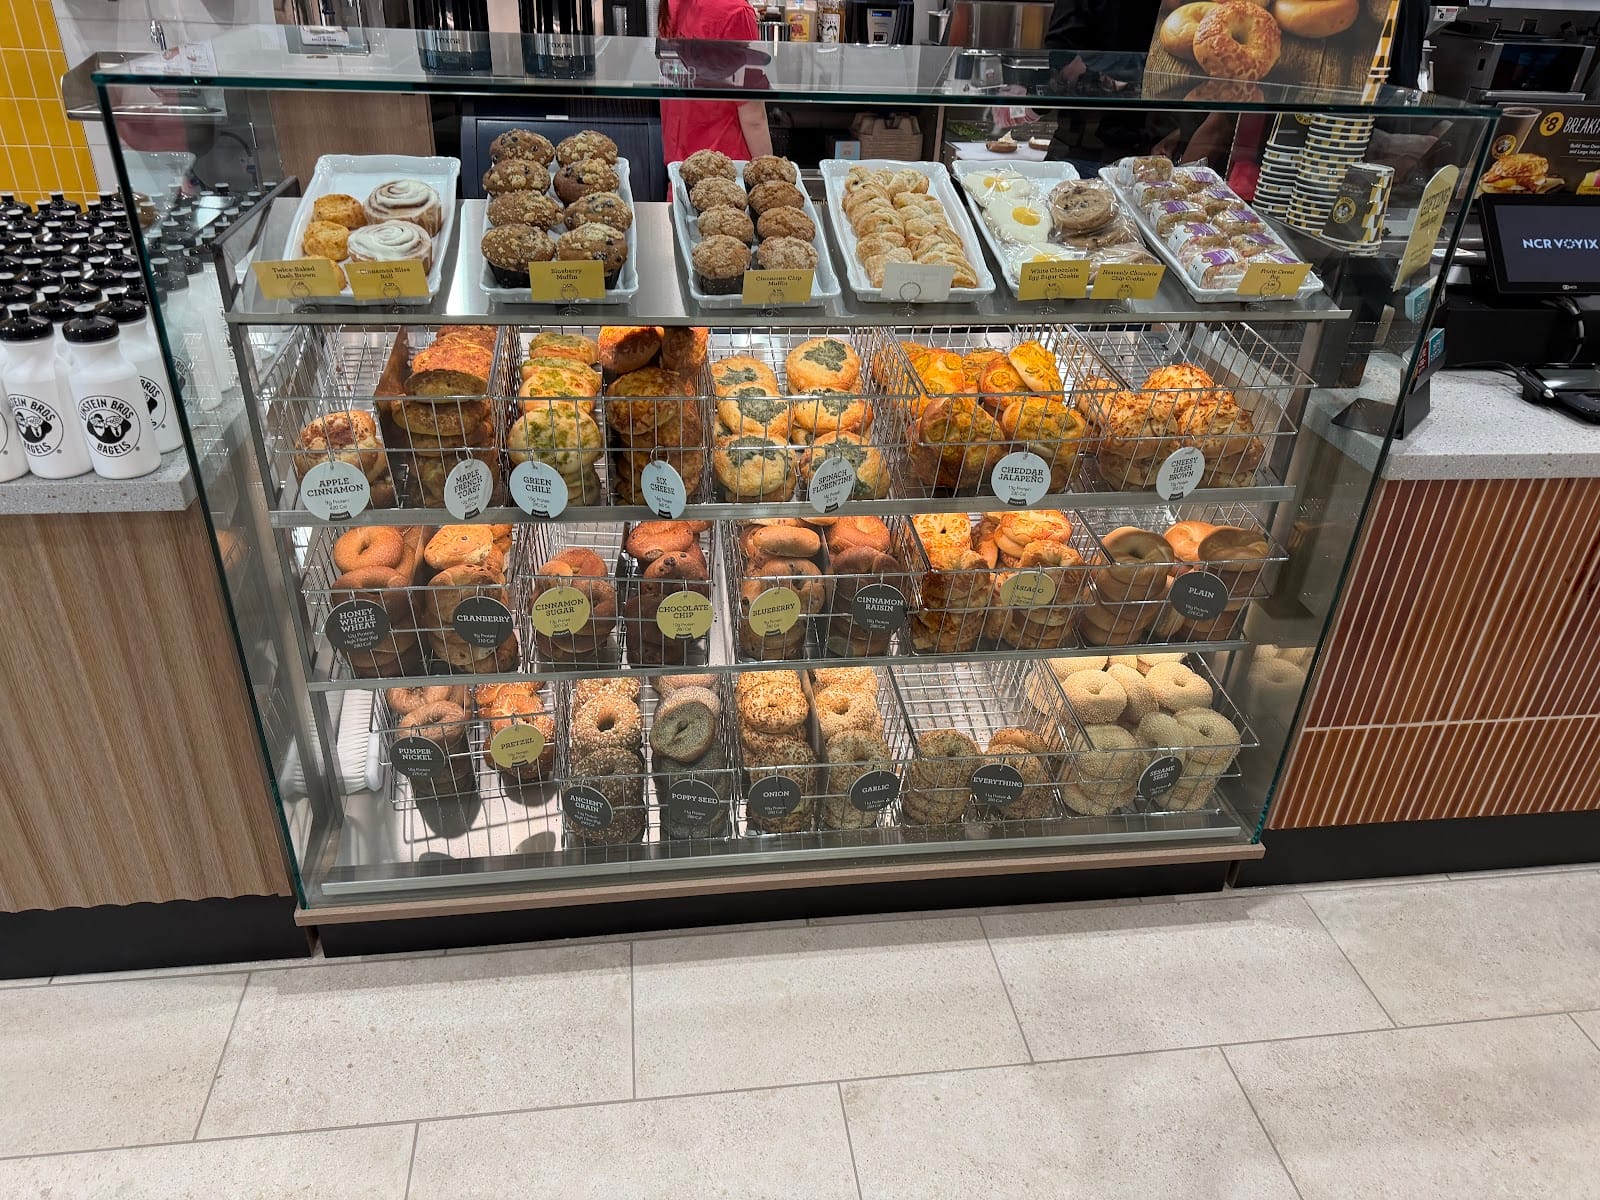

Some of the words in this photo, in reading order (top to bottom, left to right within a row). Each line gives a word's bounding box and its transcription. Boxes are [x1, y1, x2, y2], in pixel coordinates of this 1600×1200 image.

[1544, 115, 1559, 132] $8
[1562, 116, 1600, 134] BREAKF
[1522, 238, 1552, 249] NCR
[1553, 238, 1599, 249] VOYIX
[174, 360, 188, 376] ROS
[30, 401, 56, 422] BROS
[80, 398, 108, 422] EINSTEIN
[110, 400, 134, 420] BROS
[24, 442, 52, 455] BAGELS
[96, 442, 131, 455] BAGELS
[1171, 456, 1198, 468] CHEESY
[1001, 466, 1044, 476] CHEDDAR
[1172, 464, 1192, 474] HASH
[455, 468, 480, 484] MAPLE
[523, 476, 552, 487] GREEN
[818, 469, 848, 485] SPINACH
[1168, 470, 1194, 481] BROWN
[319, 477, 350, 488] APPLE
[454, 476, 483, 494] FRENCH
[650, 482, 676, 495] CHEESE
[812, 474, 853, 494] FLORENTINE
[306, 484, 364, 497] CINNAMON
[457, 484, 480, 499] TOAST
[525, 484, 552, 494] CHILE
[1188, 586, 1215, 598] PLAIN
[536, 598, 584, 611] CINNAMON
[856, 596, 904, 606] CINNAMON
[339, 608, 374, 620] HONEY
[546, 606, 575, 616] SUGAR
[658, 604, 709, 613] CHOCOLATE
[752, 603, 796, 617] BLUEBERRY
[865, 604, 894, 612] RAISIN
[340, 614, 376, 627] WHOLE
[456, 614, 510, 623] CRANBERRY
[340, 621, 377, 633] WHEAT
[500, 738, 534, 750] PRETZEL
[1150, 765, 1176, 777] SESAME
[1152, 772, 1169, 782] SEED
[973, 776, 1023, 788] EVERYTHING
[762, 790, 790, 798] ONION
[862, 784, 890, 793] GARLIC
[570, 794, 604, 808] ANCIENT
[671, 792, 697, 802] POPPY
[698, 796, 718, 804] SEED
[574, 802, 599, 813] GRAIN
